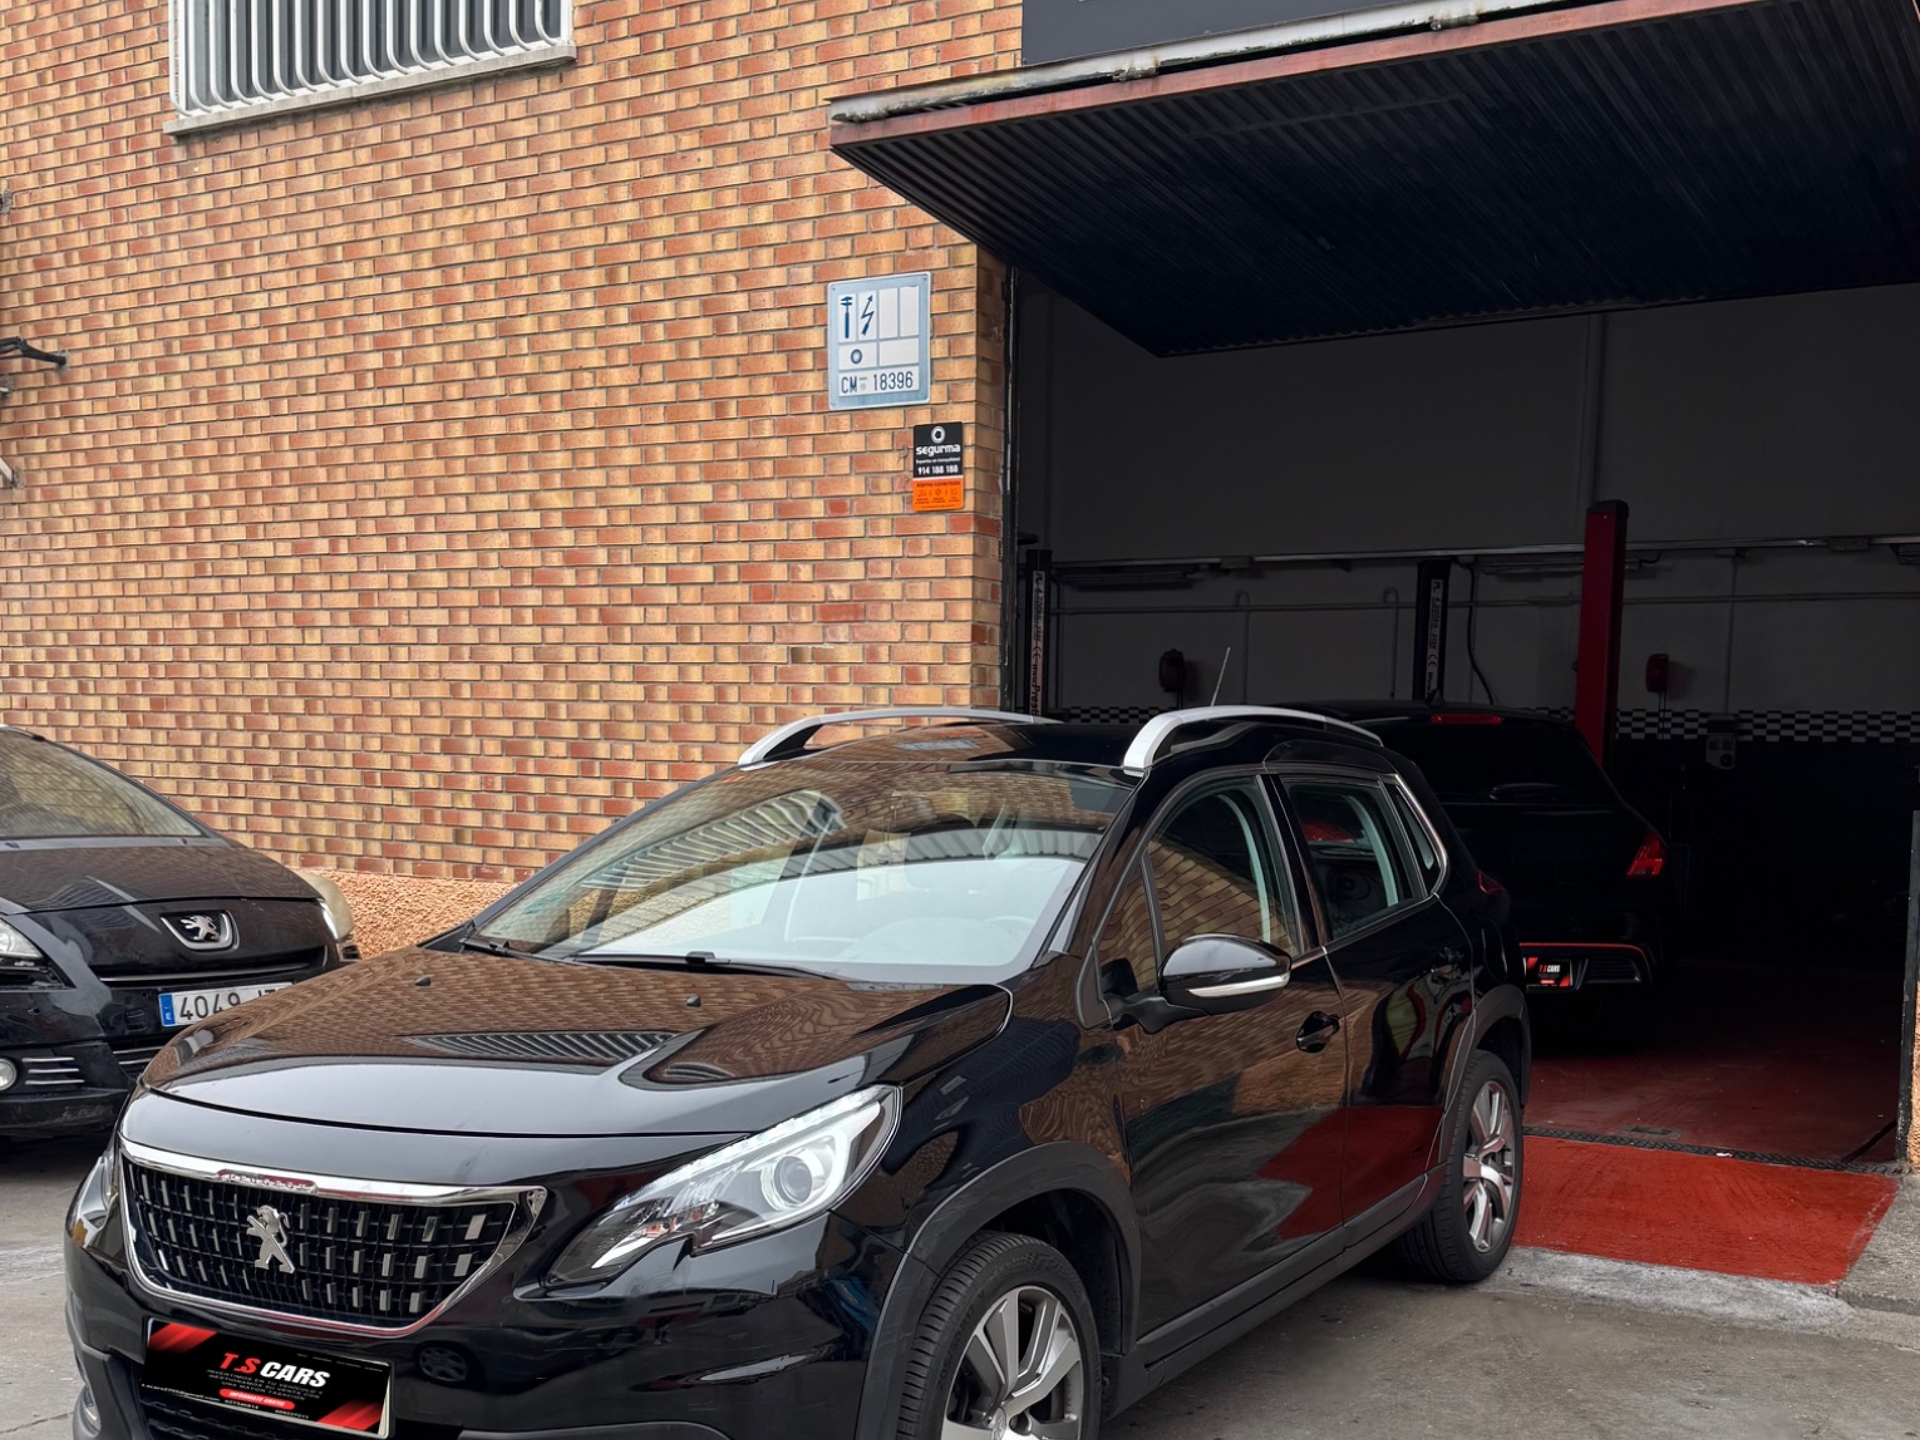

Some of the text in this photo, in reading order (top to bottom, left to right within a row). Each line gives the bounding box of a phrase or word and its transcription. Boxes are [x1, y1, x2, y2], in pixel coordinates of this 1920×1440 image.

[873, 370, 913, 391] 18396
[915, 443, 961, 457] segurma
[180, 992, 241, 1020] 4049
[259, 1361, 331, 1387] CARS
